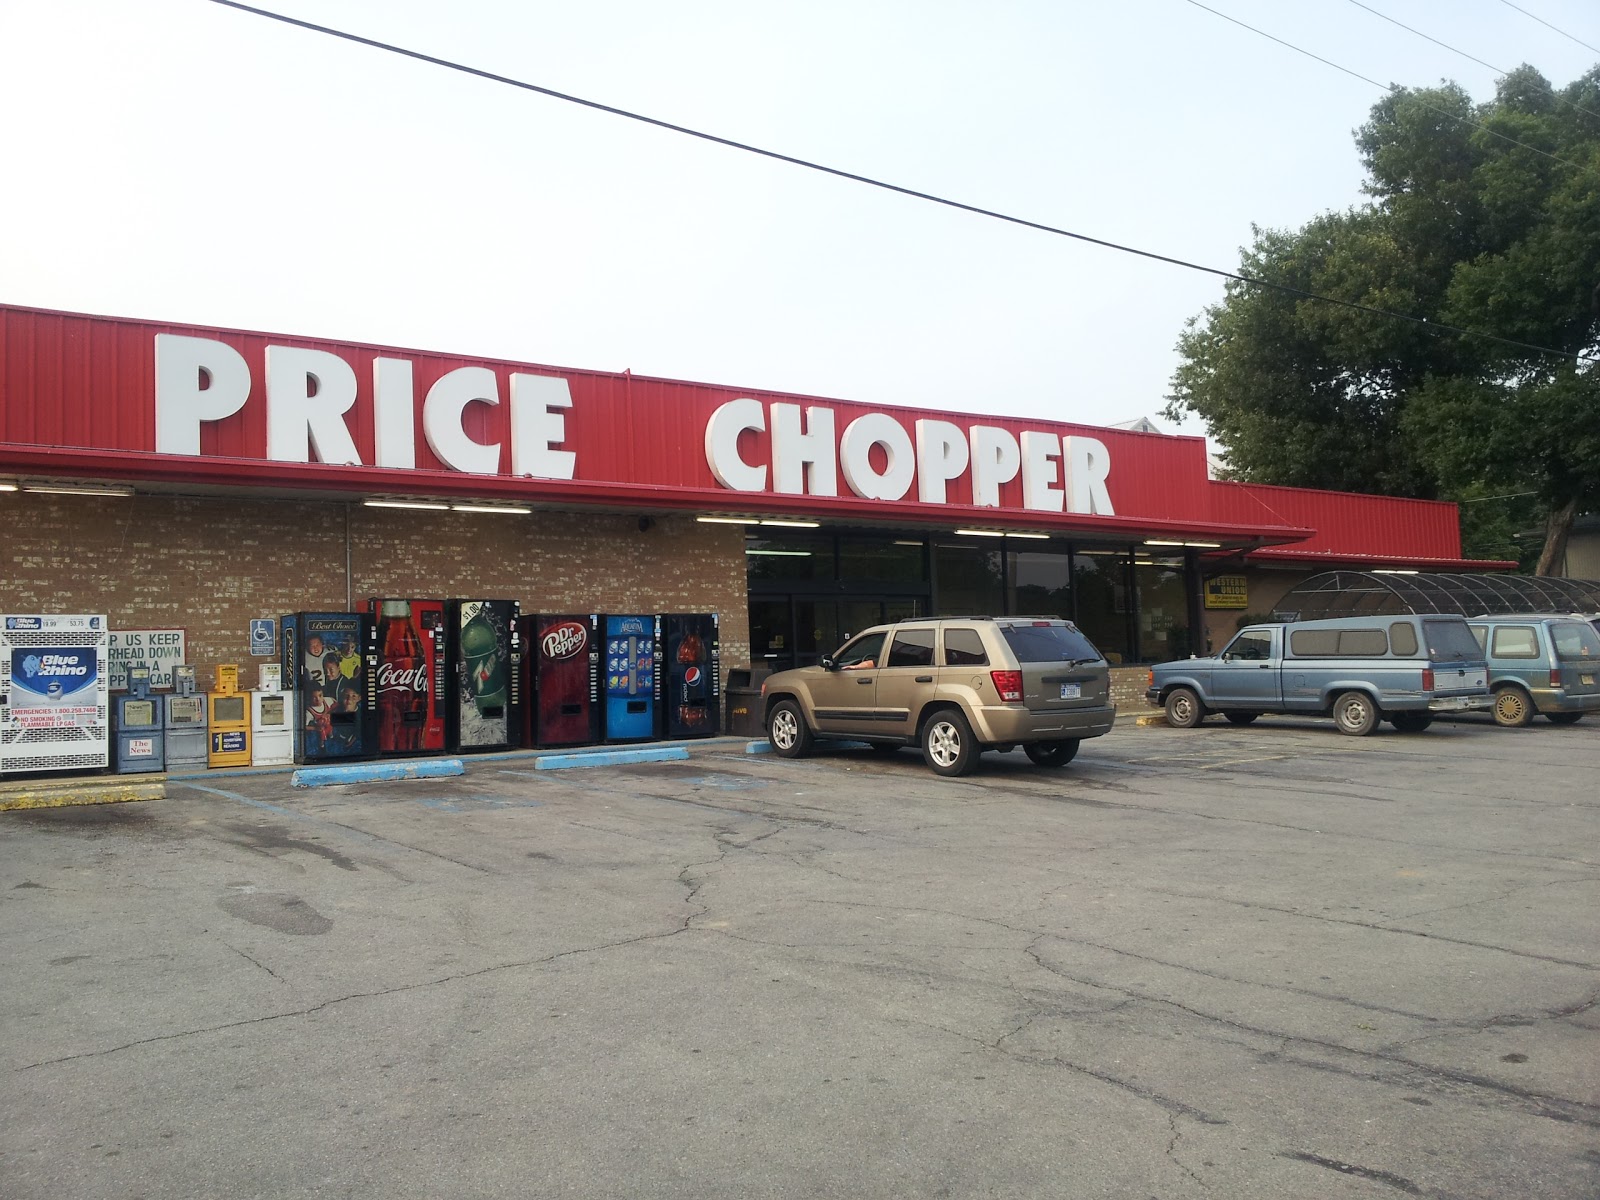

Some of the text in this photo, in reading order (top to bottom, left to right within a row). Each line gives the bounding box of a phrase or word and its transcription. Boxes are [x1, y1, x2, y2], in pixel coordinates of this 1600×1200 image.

[154, 333, 1115, 516] PRICE CHOPPER
[1209, 578, 1245, 586] WESTERN
[1221, 586, 1246, 594] UNION
[463, 603, 479, 620] $1.00
[311, 621, 356, 630] Best Choice
[126, 634, 142, 646] US
[149, 633, 180, 646] KEEP
[558, 627, 575, 643] Dr
[545, 630, 584, 658] Pepper
[108, 646, 181, 660] RHEAD DOWN
[42, 655, 79, 665] Blue
[38, 665, 87, 676] Rhino
[152, 661, 160, 672] A
[150, 673, 172, 685] CAR
